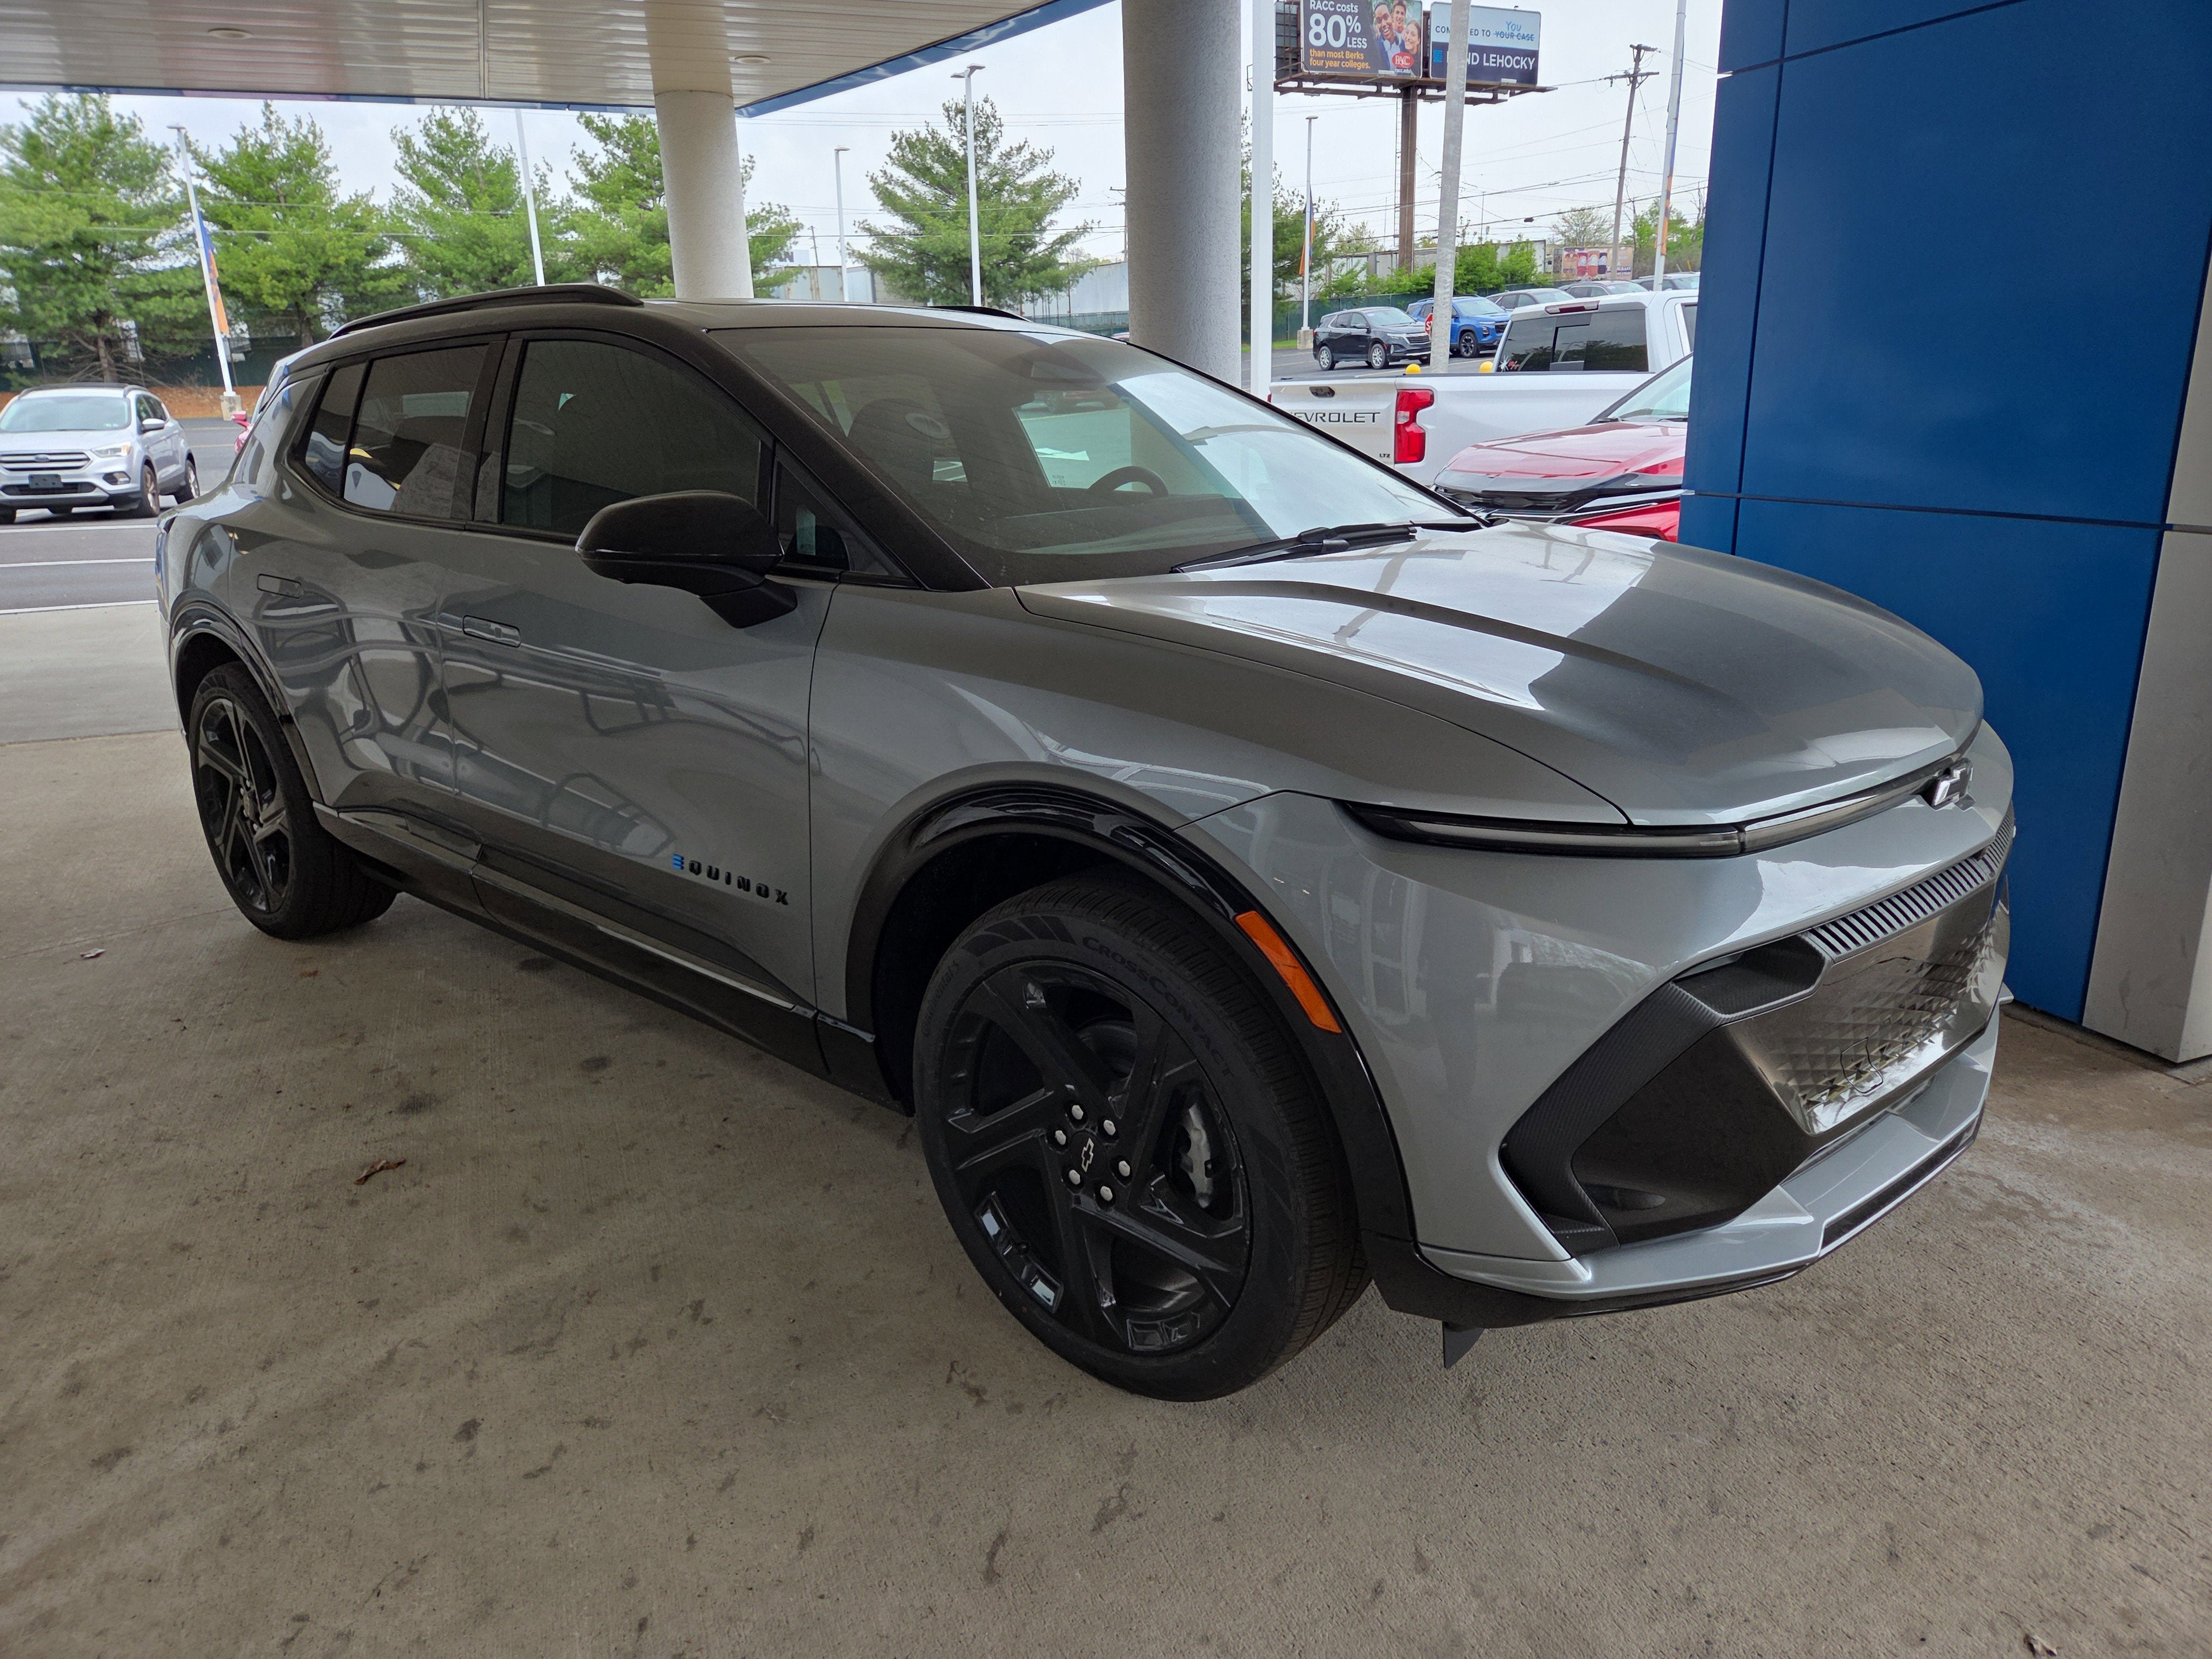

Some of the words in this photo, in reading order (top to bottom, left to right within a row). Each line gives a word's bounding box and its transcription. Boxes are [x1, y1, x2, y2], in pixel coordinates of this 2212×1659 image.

[1310, 0, 1334, 11] RACC
[1336, 3, 1358, 13] costs
[1506, 21, 1522, 31] YOU
[1347, 37, 1367, 49] LESS
[1309, 48, 1326, 57] than
[1327, 50, 1344, 59] most
[1345, 50, 1364, 60] Berks
[1309, 57, 1324, 66] four
[1324, 60, 1340, 69] year
[1341, 60, 1371, 70] colleges.
[1483, 53, 1535, 70] LEHOCKY
[671, 853, 788, 905] EQUINOX
